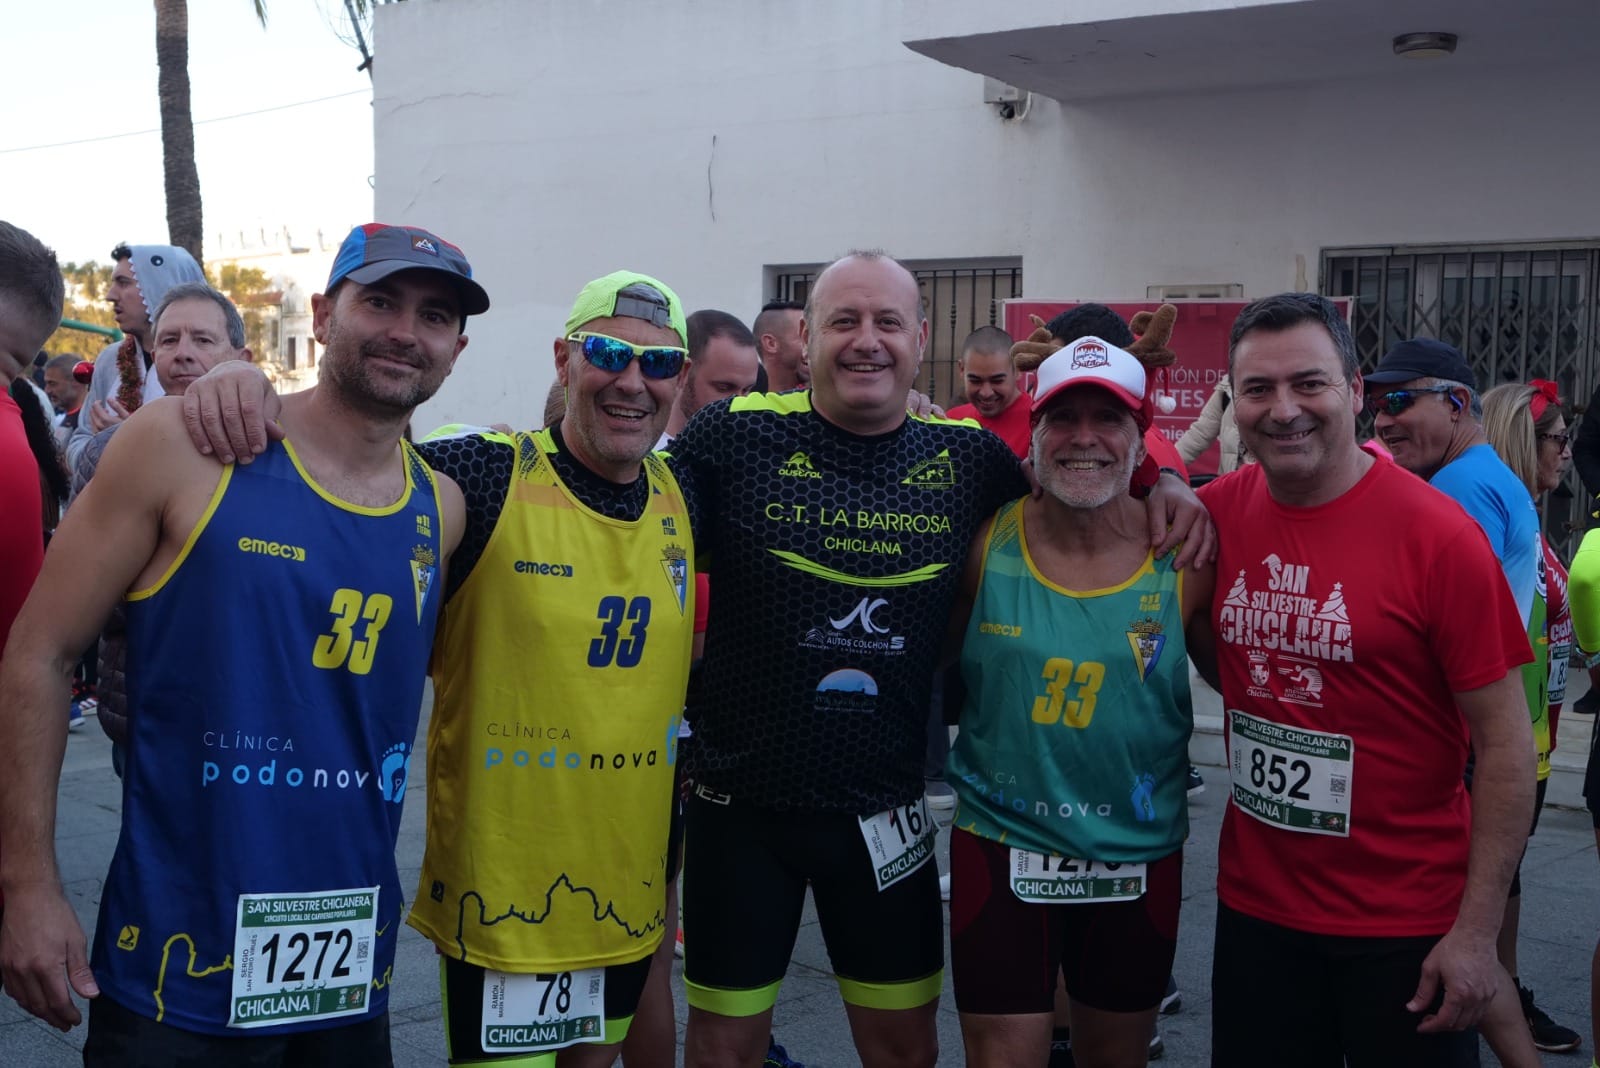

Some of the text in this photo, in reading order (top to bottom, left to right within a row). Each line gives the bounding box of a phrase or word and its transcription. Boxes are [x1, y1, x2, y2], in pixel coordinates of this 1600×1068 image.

[766, 503, 951, 533] C.T. LA BARROSA
[825, 537, 902, 555] CHICLANA
[1268, 563, 1310, 595] SAN
[1251, 590, 1317, 618] SILVESTRE
[312, 588, 392, 675] 33
[587, 596, 651, 668] 33
[827, 637, 851, 647] AUTOS
[1220, 606, 1353, 662] CHICLANA
[1031, 657, 1105, 728] 33
[203, 731, 294, 751] CLÍNICA
[487, 722, 571, 740] CLÍNICA
[1235, 715, 1347, 750] SAN SILVESTRE CHICLANERA
[485, 747, 657, 771] podonova
[1250, 747, 1311, 801] 852
[203, 760, 382, 791] podonov
[1235, 787, 1280, 819] CHICLANA
[881, 843, 927, 881] CHICLANA
[1016, 881, 1085, 896] CHICLANA
[247, 895, 371, 914] SAN SILVESTRE CHICLANERA
[241, 949, 249, 978] SERGIO
[261, 928, 353, 984] 1272
[237, 994, 310, 1018] CHICLANA
[536, 971, 572, 1016] 78
[489, 1027, 558, 1044] CHICLANA
